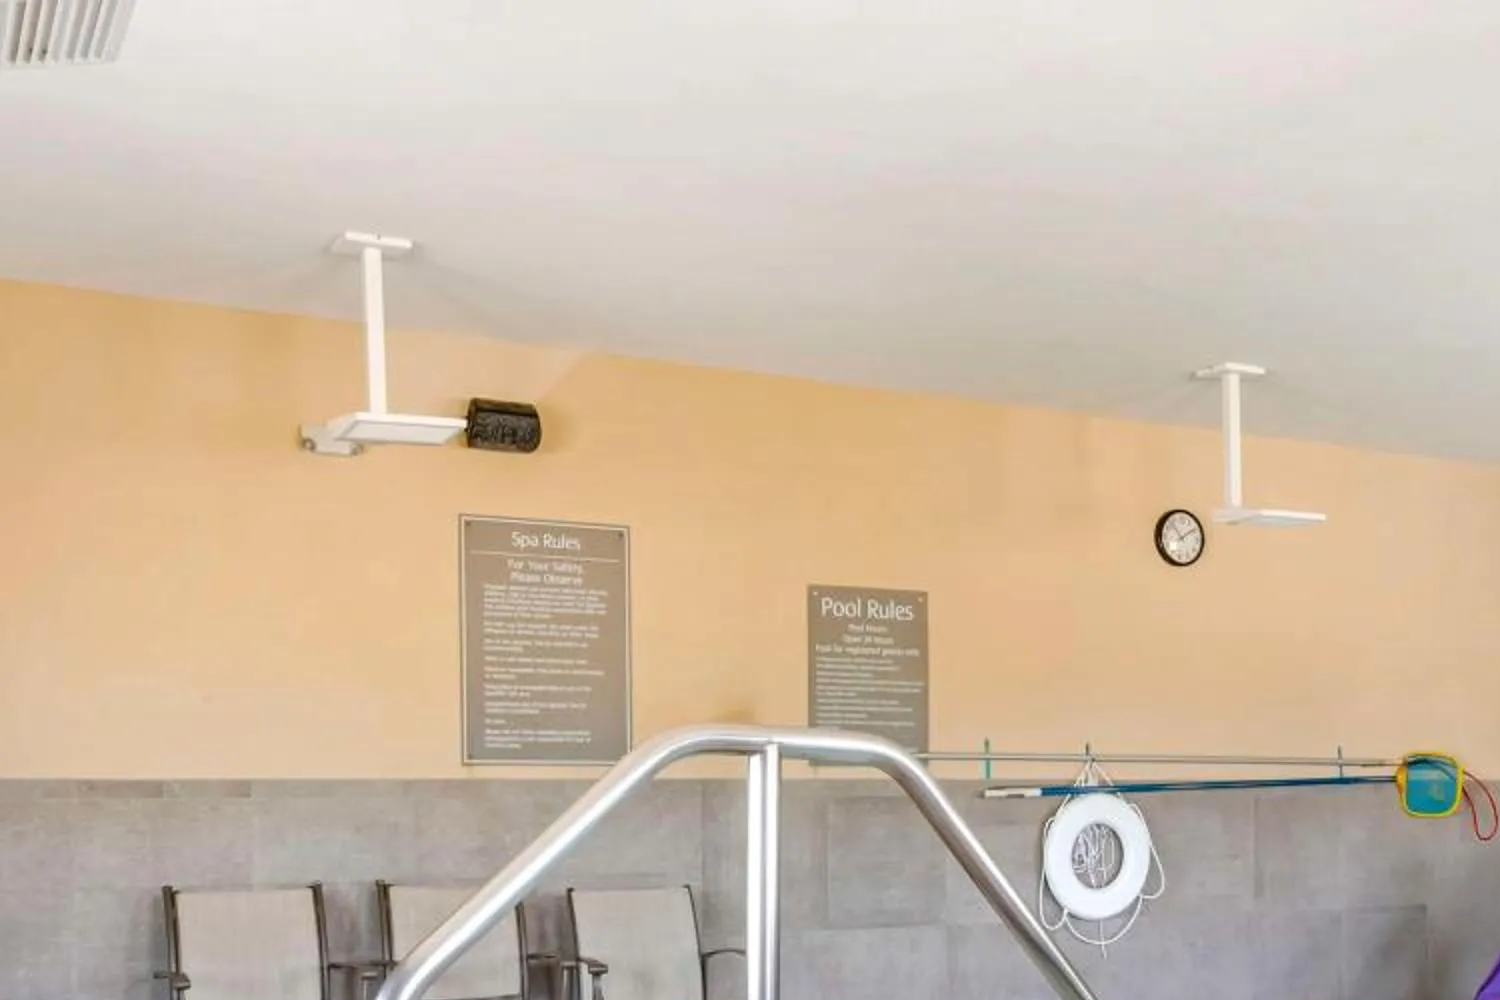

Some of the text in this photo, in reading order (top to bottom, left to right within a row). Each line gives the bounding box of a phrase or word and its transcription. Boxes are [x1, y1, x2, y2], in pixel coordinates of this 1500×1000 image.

[512, 531, 581, 551] Spa Rules
[821, 596, 914, 621] Pool Rules
